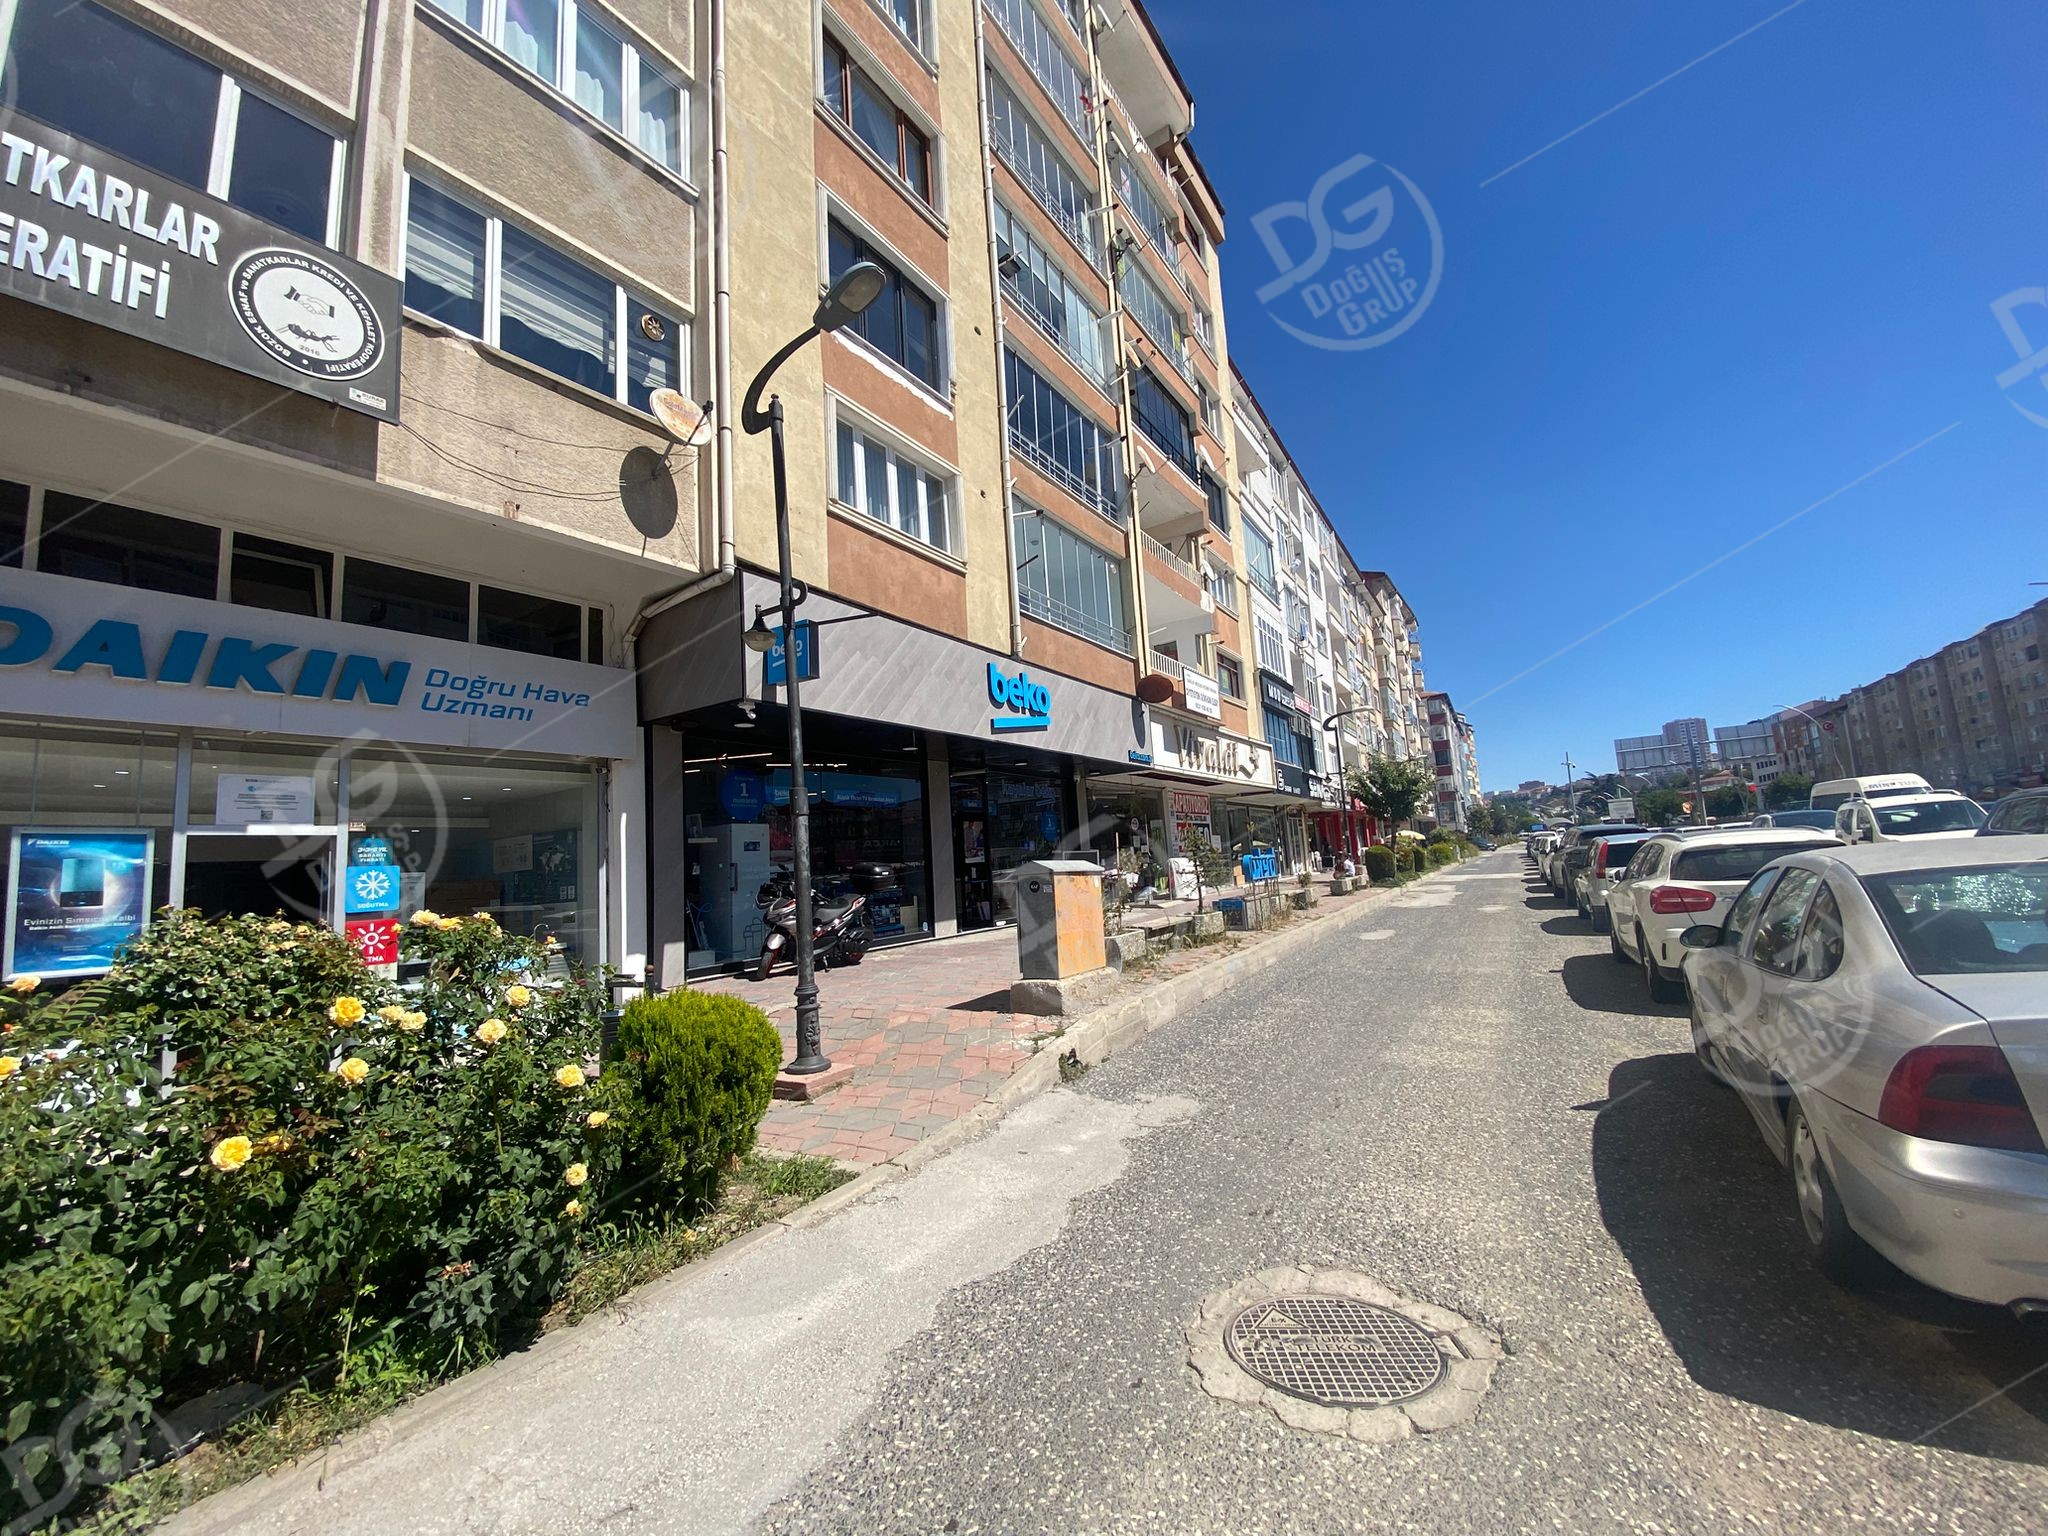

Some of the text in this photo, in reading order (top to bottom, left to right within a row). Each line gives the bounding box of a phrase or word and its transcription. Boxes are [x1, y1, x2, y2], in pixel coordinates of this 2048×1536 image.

[1, 131, 219, 266] TKARLAR
[242, 256, 310, 280] SANATKARLAR
[238, 291, 256, 323] ESNAF
[345, 287, 357, 302] VE
[356, 302, 376, 344] KEFALET
[254, 325, 292, 358] BOZOK
[299, 344, 320, 357] 2016
[425, 668, 590, 707] Doğru Hava
[989, 662, 1052, 714] beko
[421, 692, 534, 721] Uzmanı
[357, 901, 389, 909] SOĞUTMA
[24, 917, 63, 926] Evinizin
[1297, 1343, 1377, 1352] TELEKOM
